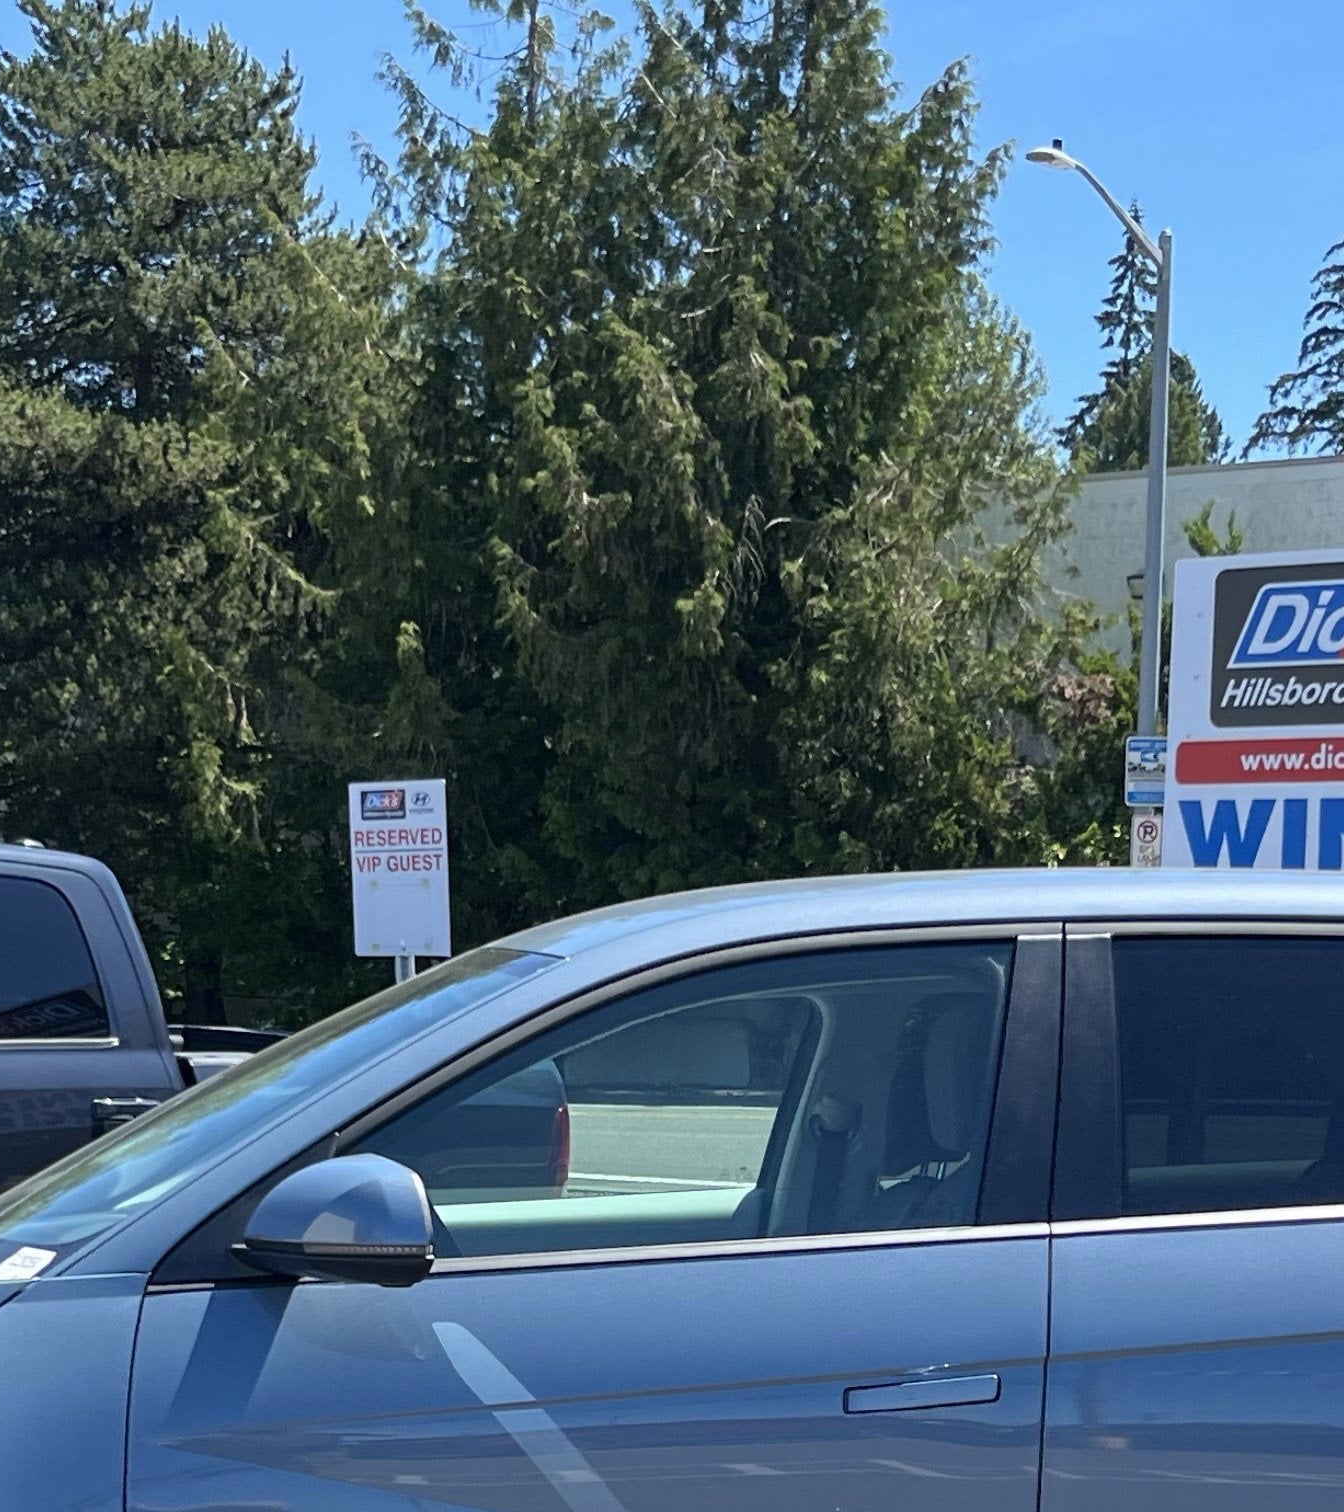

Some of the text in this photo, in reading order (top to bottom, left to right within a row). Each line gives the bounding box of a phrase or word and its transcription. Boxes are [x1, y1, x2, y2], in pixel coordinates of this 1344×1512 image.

[354, 827, 443, 848] RESERVED
[356, 853, 443, 873] VIP GUEST
